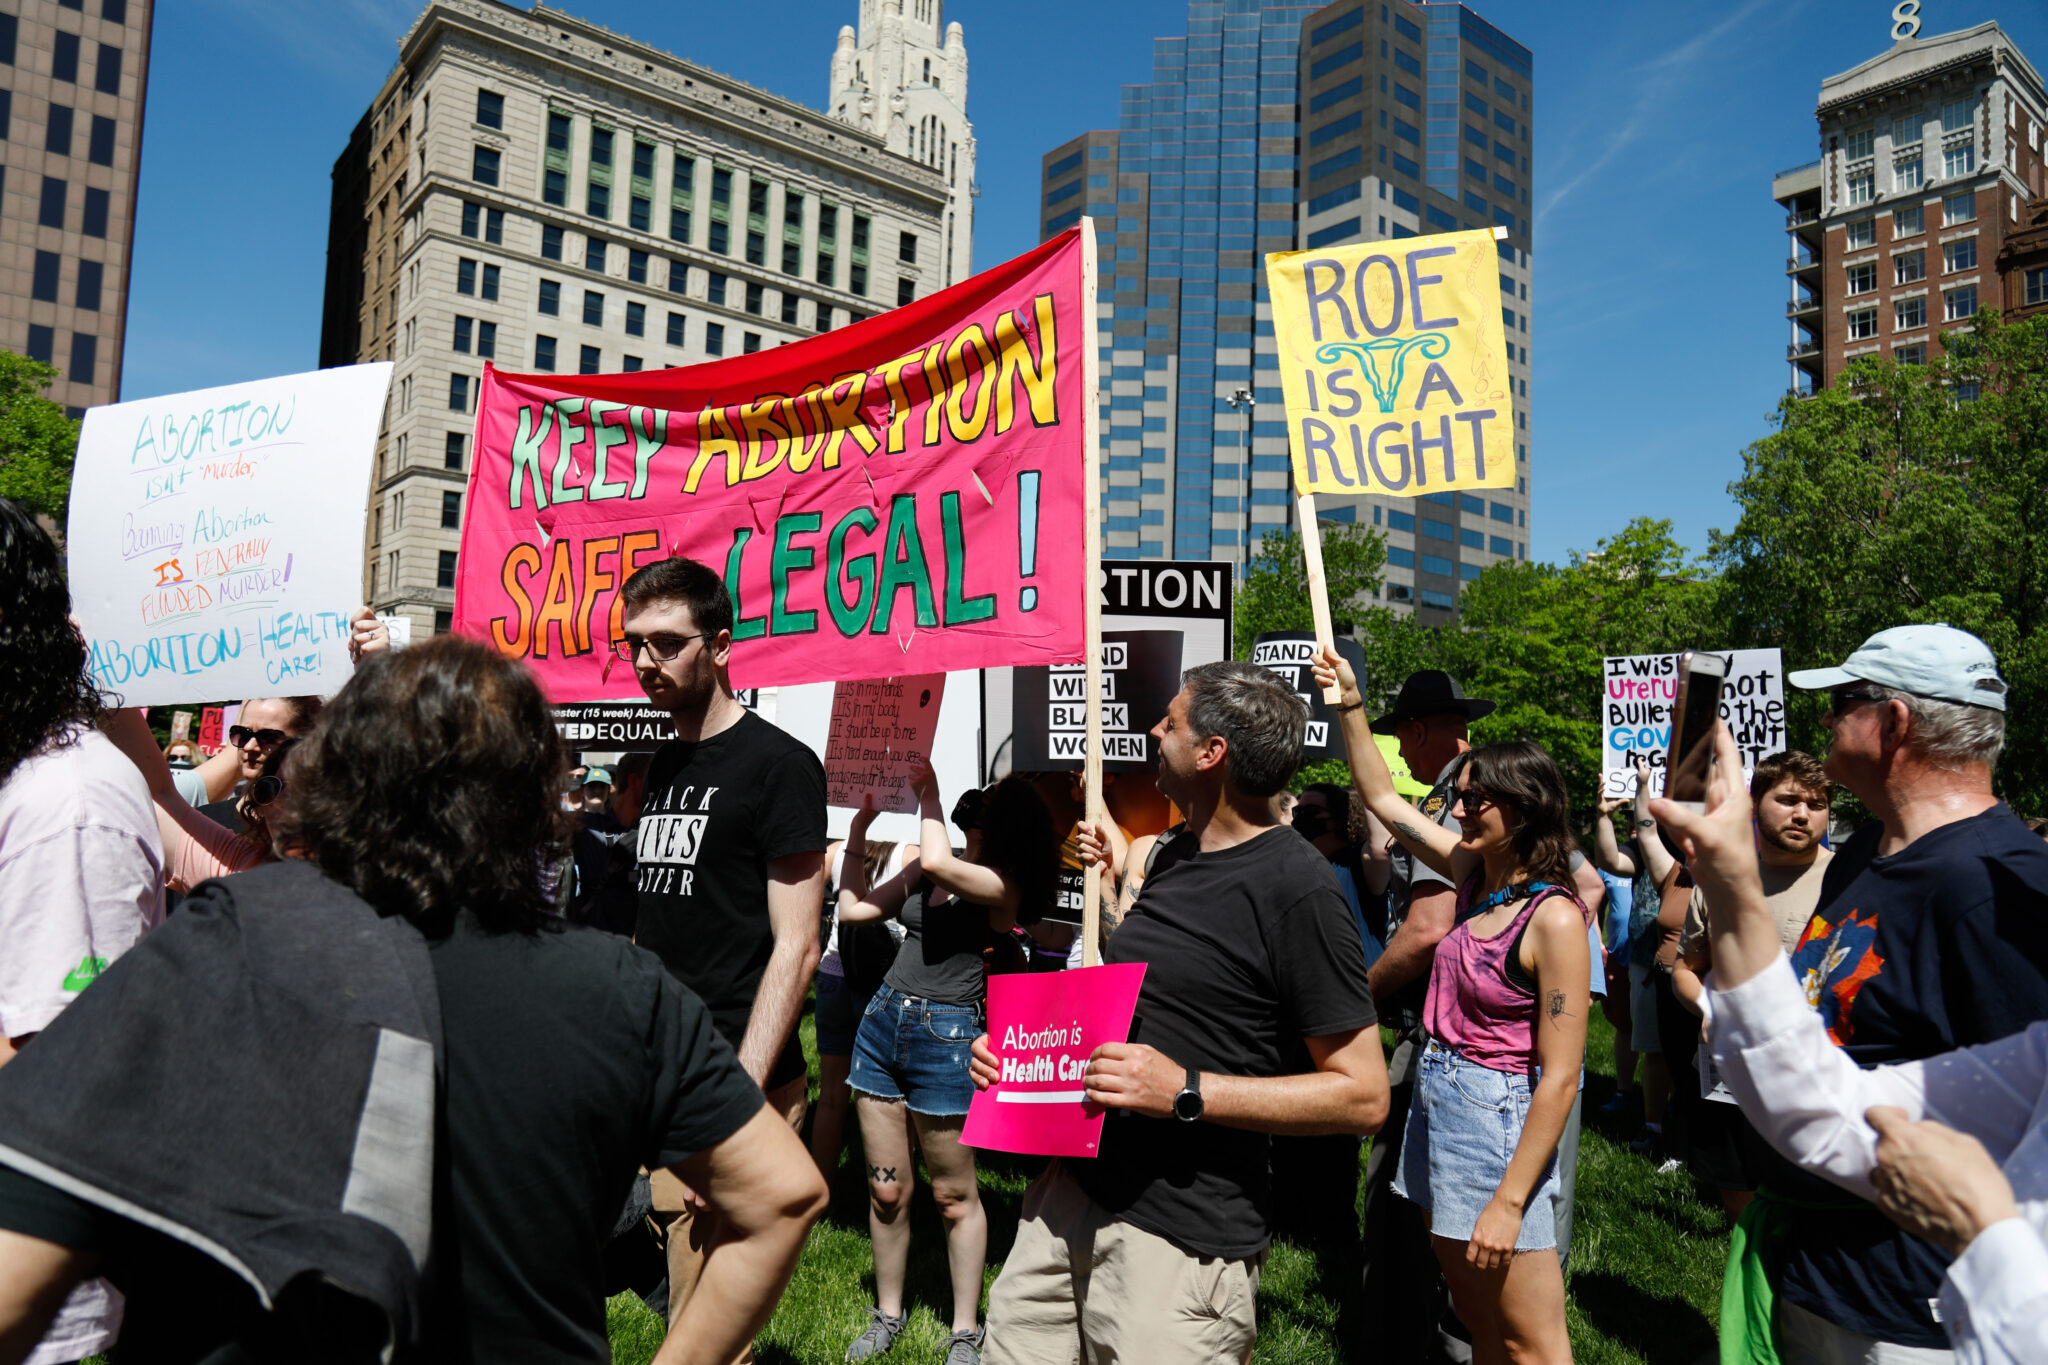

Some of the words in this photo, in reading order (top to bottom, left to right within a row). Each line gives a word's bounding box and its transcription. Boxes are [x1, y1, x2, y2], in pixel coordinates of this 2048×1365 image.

[1303, 246, 1459, 341] ROE
[681, 291, 1060, 495] ABORTION
[1305, 369, 1362, 417] IS
[1414, 362, 1464, 410] A
[131, 391, 296, 465] ABORTION
[1301, 409, 1497, 491] RIGHT
[193, 506, 275, 544] Abortion
[141, 584, 213, 624] FUNDED
[219, 552, 293, 604] MURDER!
[153, 558, 184, 587] IS
[90, 627, 241, 689] ABORTION
[258, 612, 349, 659] HEALTH
[267, 651, 322, 686] CARE!
[1254, 644, 1314, 663] STAND
[1607, 658, 1627, 676] I
[1609, 677, 1677, 700] Uteru
[583, 708, 600, 719] (15
[602, 708, 633, 719] week)
[639, 818, 702, 859] IVES
[1002, 1023, 1067, 1050] Abortion
[1070, 1020, 1082, 1046] is
[1001, 1054, 1054, 1083] Health
